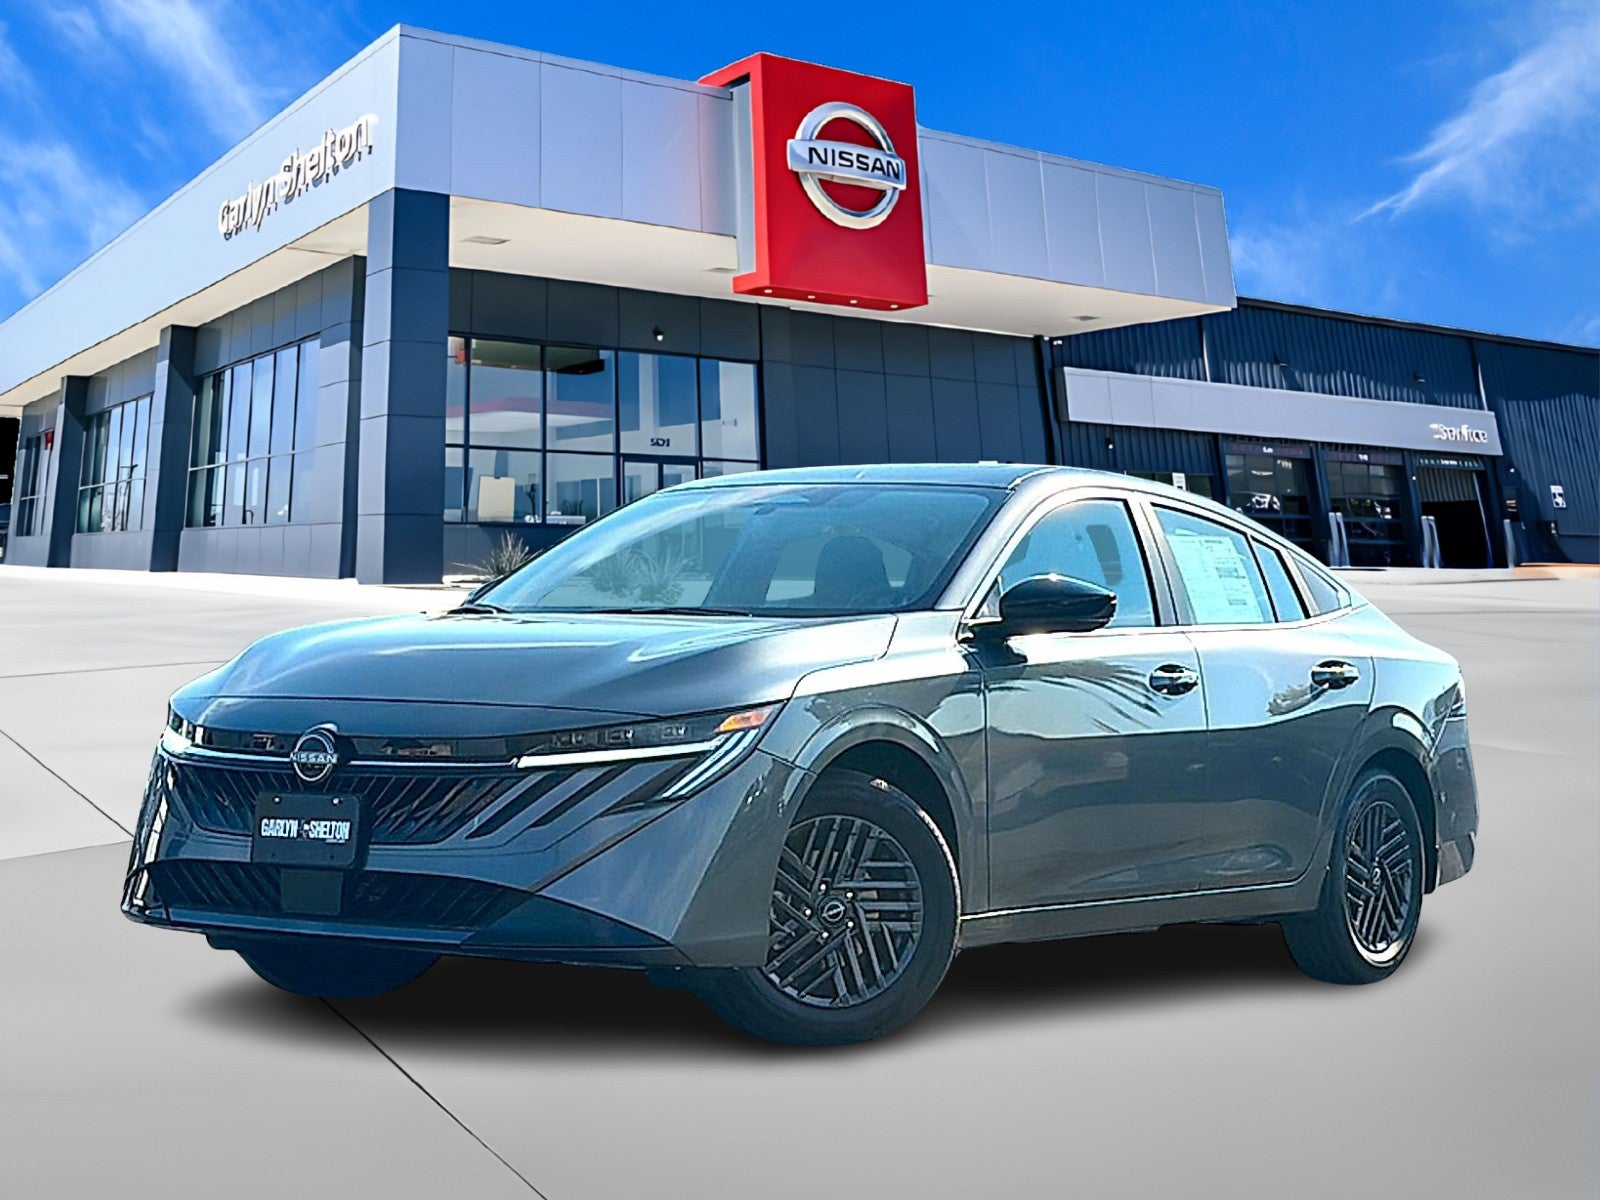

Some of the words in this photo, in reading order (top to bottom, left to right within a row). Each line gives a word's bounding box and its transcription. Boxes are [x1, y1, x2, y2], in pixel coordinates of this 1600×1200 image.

[279, 114, 373, 200] Shelton
[808, 146, 900, 180] NISSAN
[290, 751, 338, 764] NISSAN
[261, 818, 299, 838] GARLYN
[309, 820, 350, 840] SHELTON
